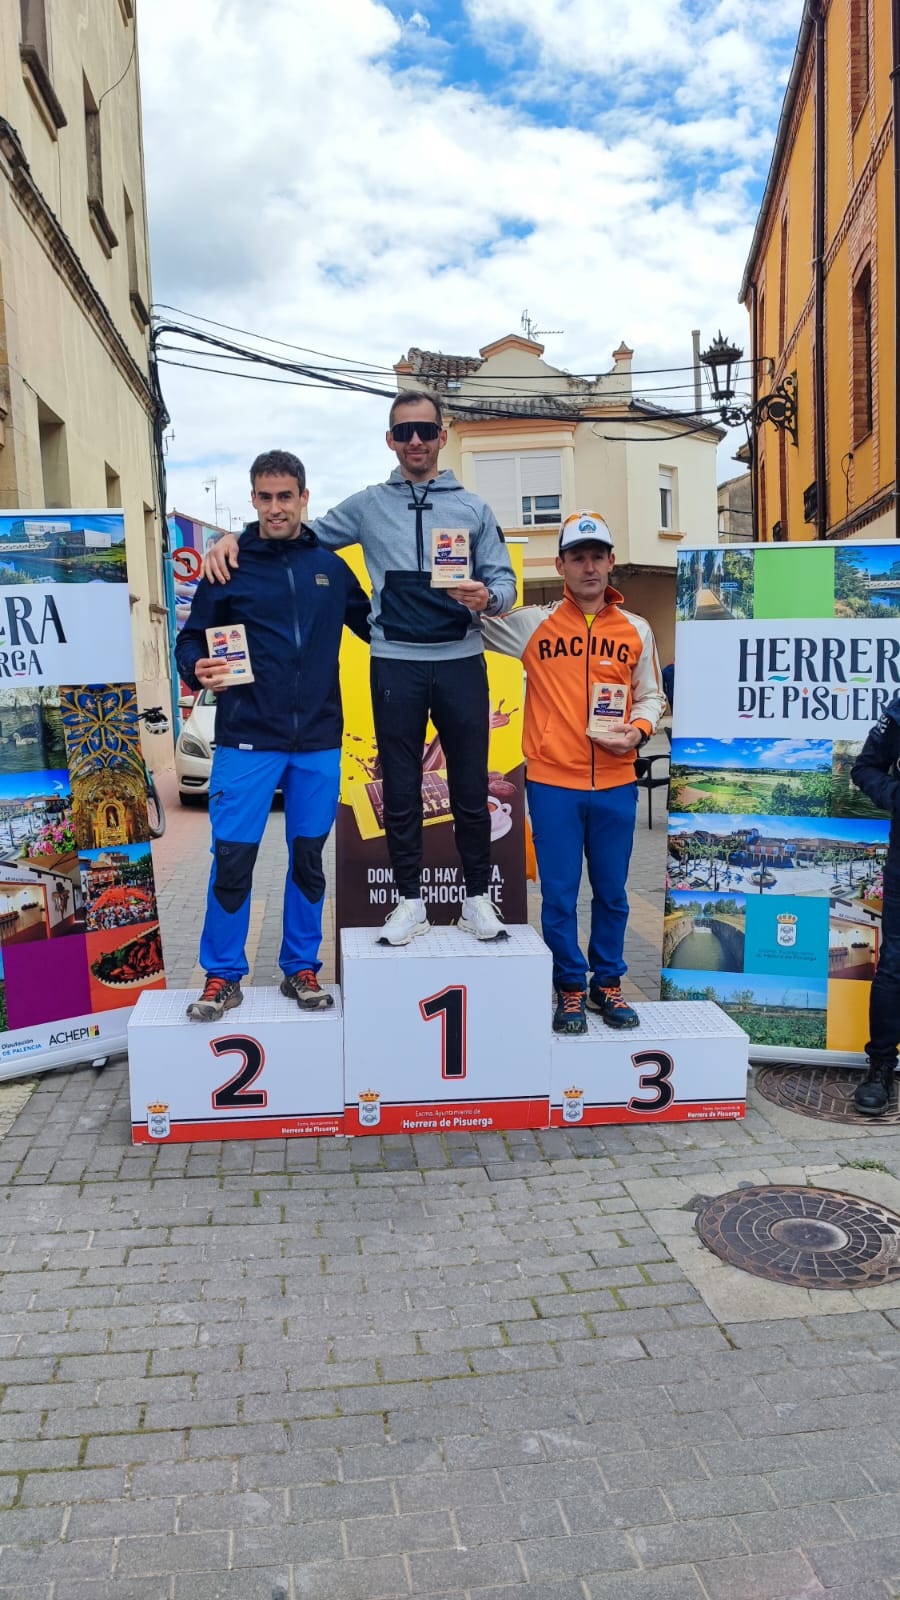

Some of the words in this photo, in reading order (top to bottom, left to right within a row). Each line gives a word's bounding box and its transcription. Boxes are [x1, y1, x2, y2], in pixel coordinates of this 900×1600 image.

[0, 595, 67, 646] RA
[538, 636, 630, 664] RACING
[738, 686, 775, 719] DE
[434, 867, 458, 883] HAY
[369, 888, 387, 904] NO
[49, 1027, 90, 1046] ACHEPI
[418, 984, 467, 1080] 1
[12, 1043, 42, 1055] PALENCIA
[208, 1033, 268, 1111] 2
[626, 1049, 675, 1114] 3
[473, 1107, 481, 1115] de
[281, 1127, 304, 1135] Herrera
[313, 1125, 339, 1133] Pisuerga
[402, 1119, 438, 1129] Herrera
[439, 1117, 451, 1127] de
[453, 1117, 493, 1128] Pisuerga
